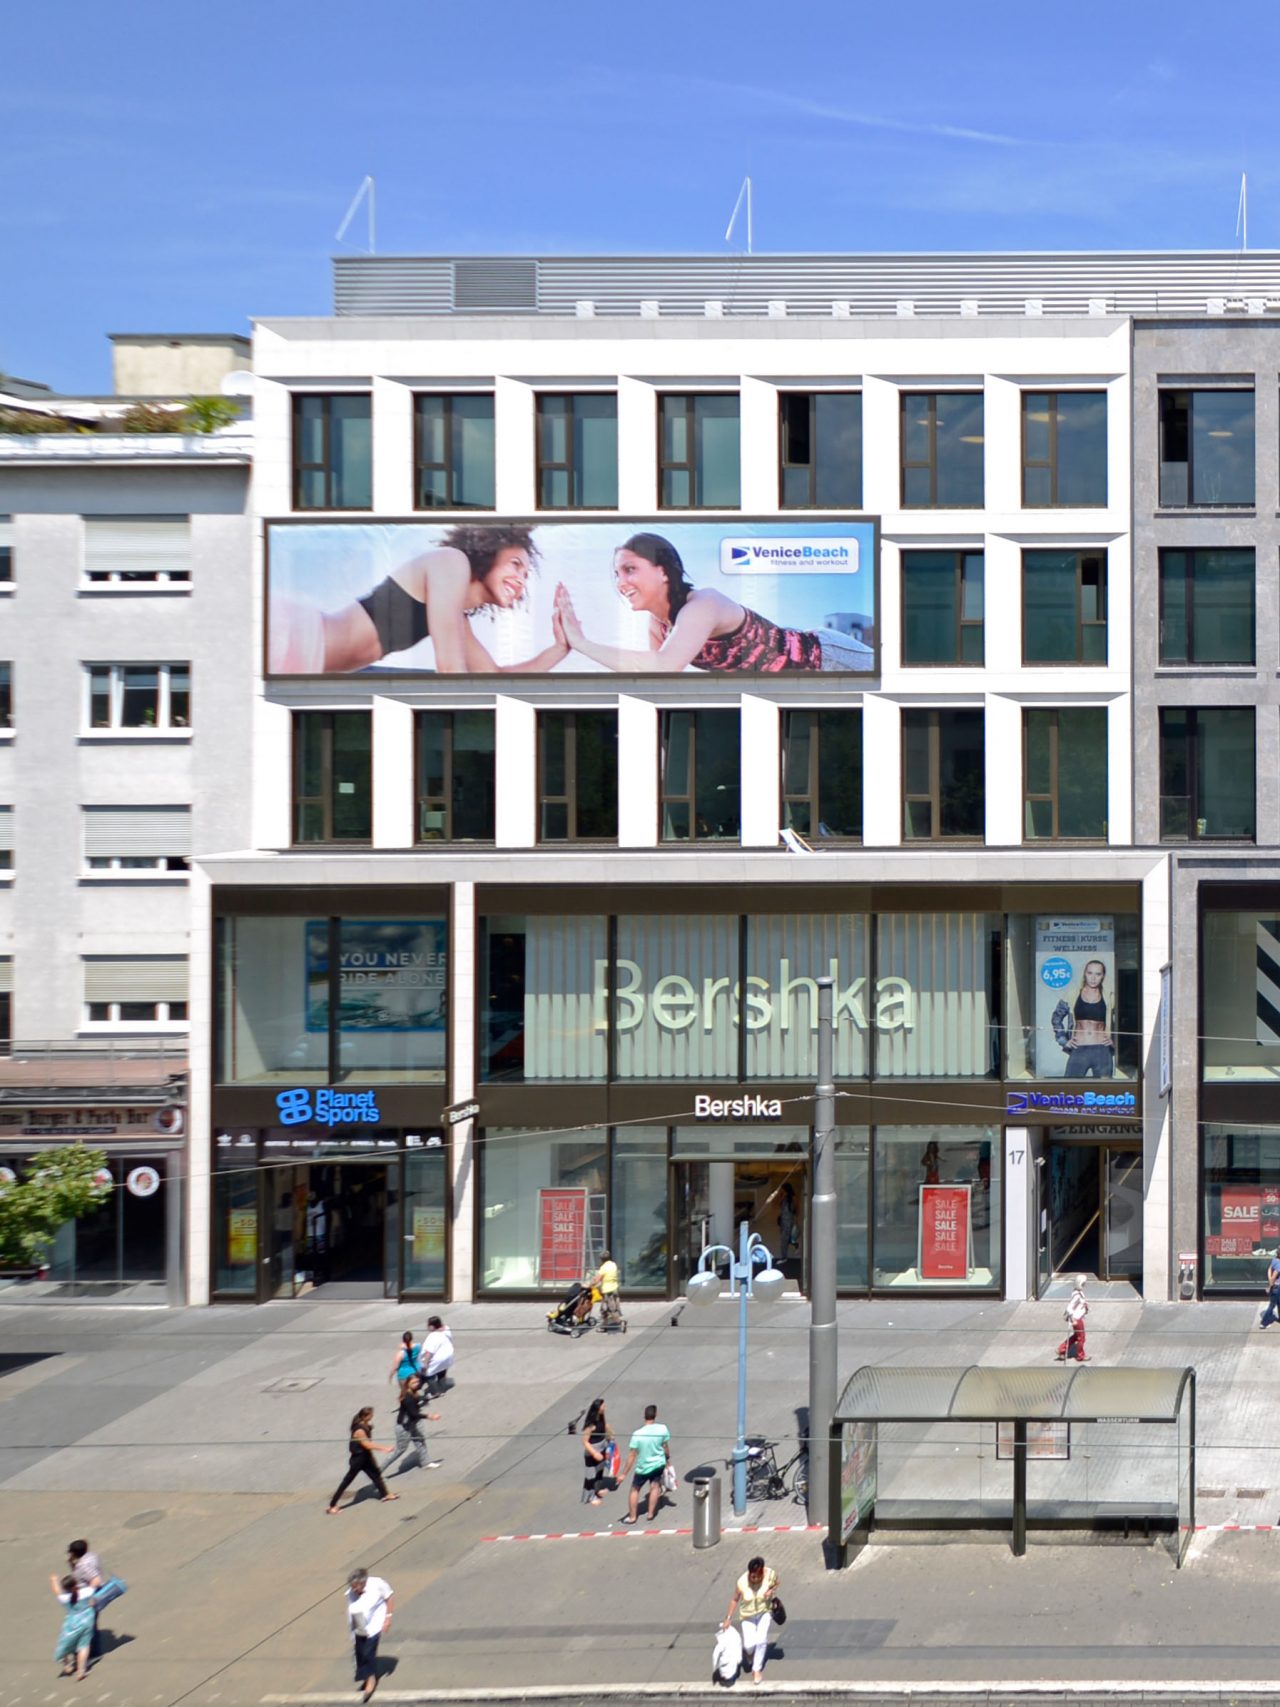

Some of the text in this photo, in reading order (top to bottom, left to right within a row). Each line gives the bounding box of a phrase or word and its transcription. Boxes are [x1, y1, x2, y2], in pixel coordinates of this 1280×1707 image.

[752, 546, 849, 558] VeniceBeach
[340, 953, 378, 966] YOU
[594, 958, 914, 1031] Bershka
[316, 1089, 375, 1107] Planet
[1030, 1092, 1135, 1106] VeniceBeach
[695, 1094, 782, 1117] Bershka
[315, 1104, 380, 1127] Sports
[1009, 1150, 1025, 1165] 17
[935, 1199, 957, 1209] SALE
[935, 1210, 957, 1220] SALE
[1223, 1206, 1260, 1218] SALE
[552, 1222, 575, 1232] SALE
[935, 1221, 957, 1231] SALE
[935, 1231, 957, 1241] SALE
[935, 1242, 957, 1251] SALE
